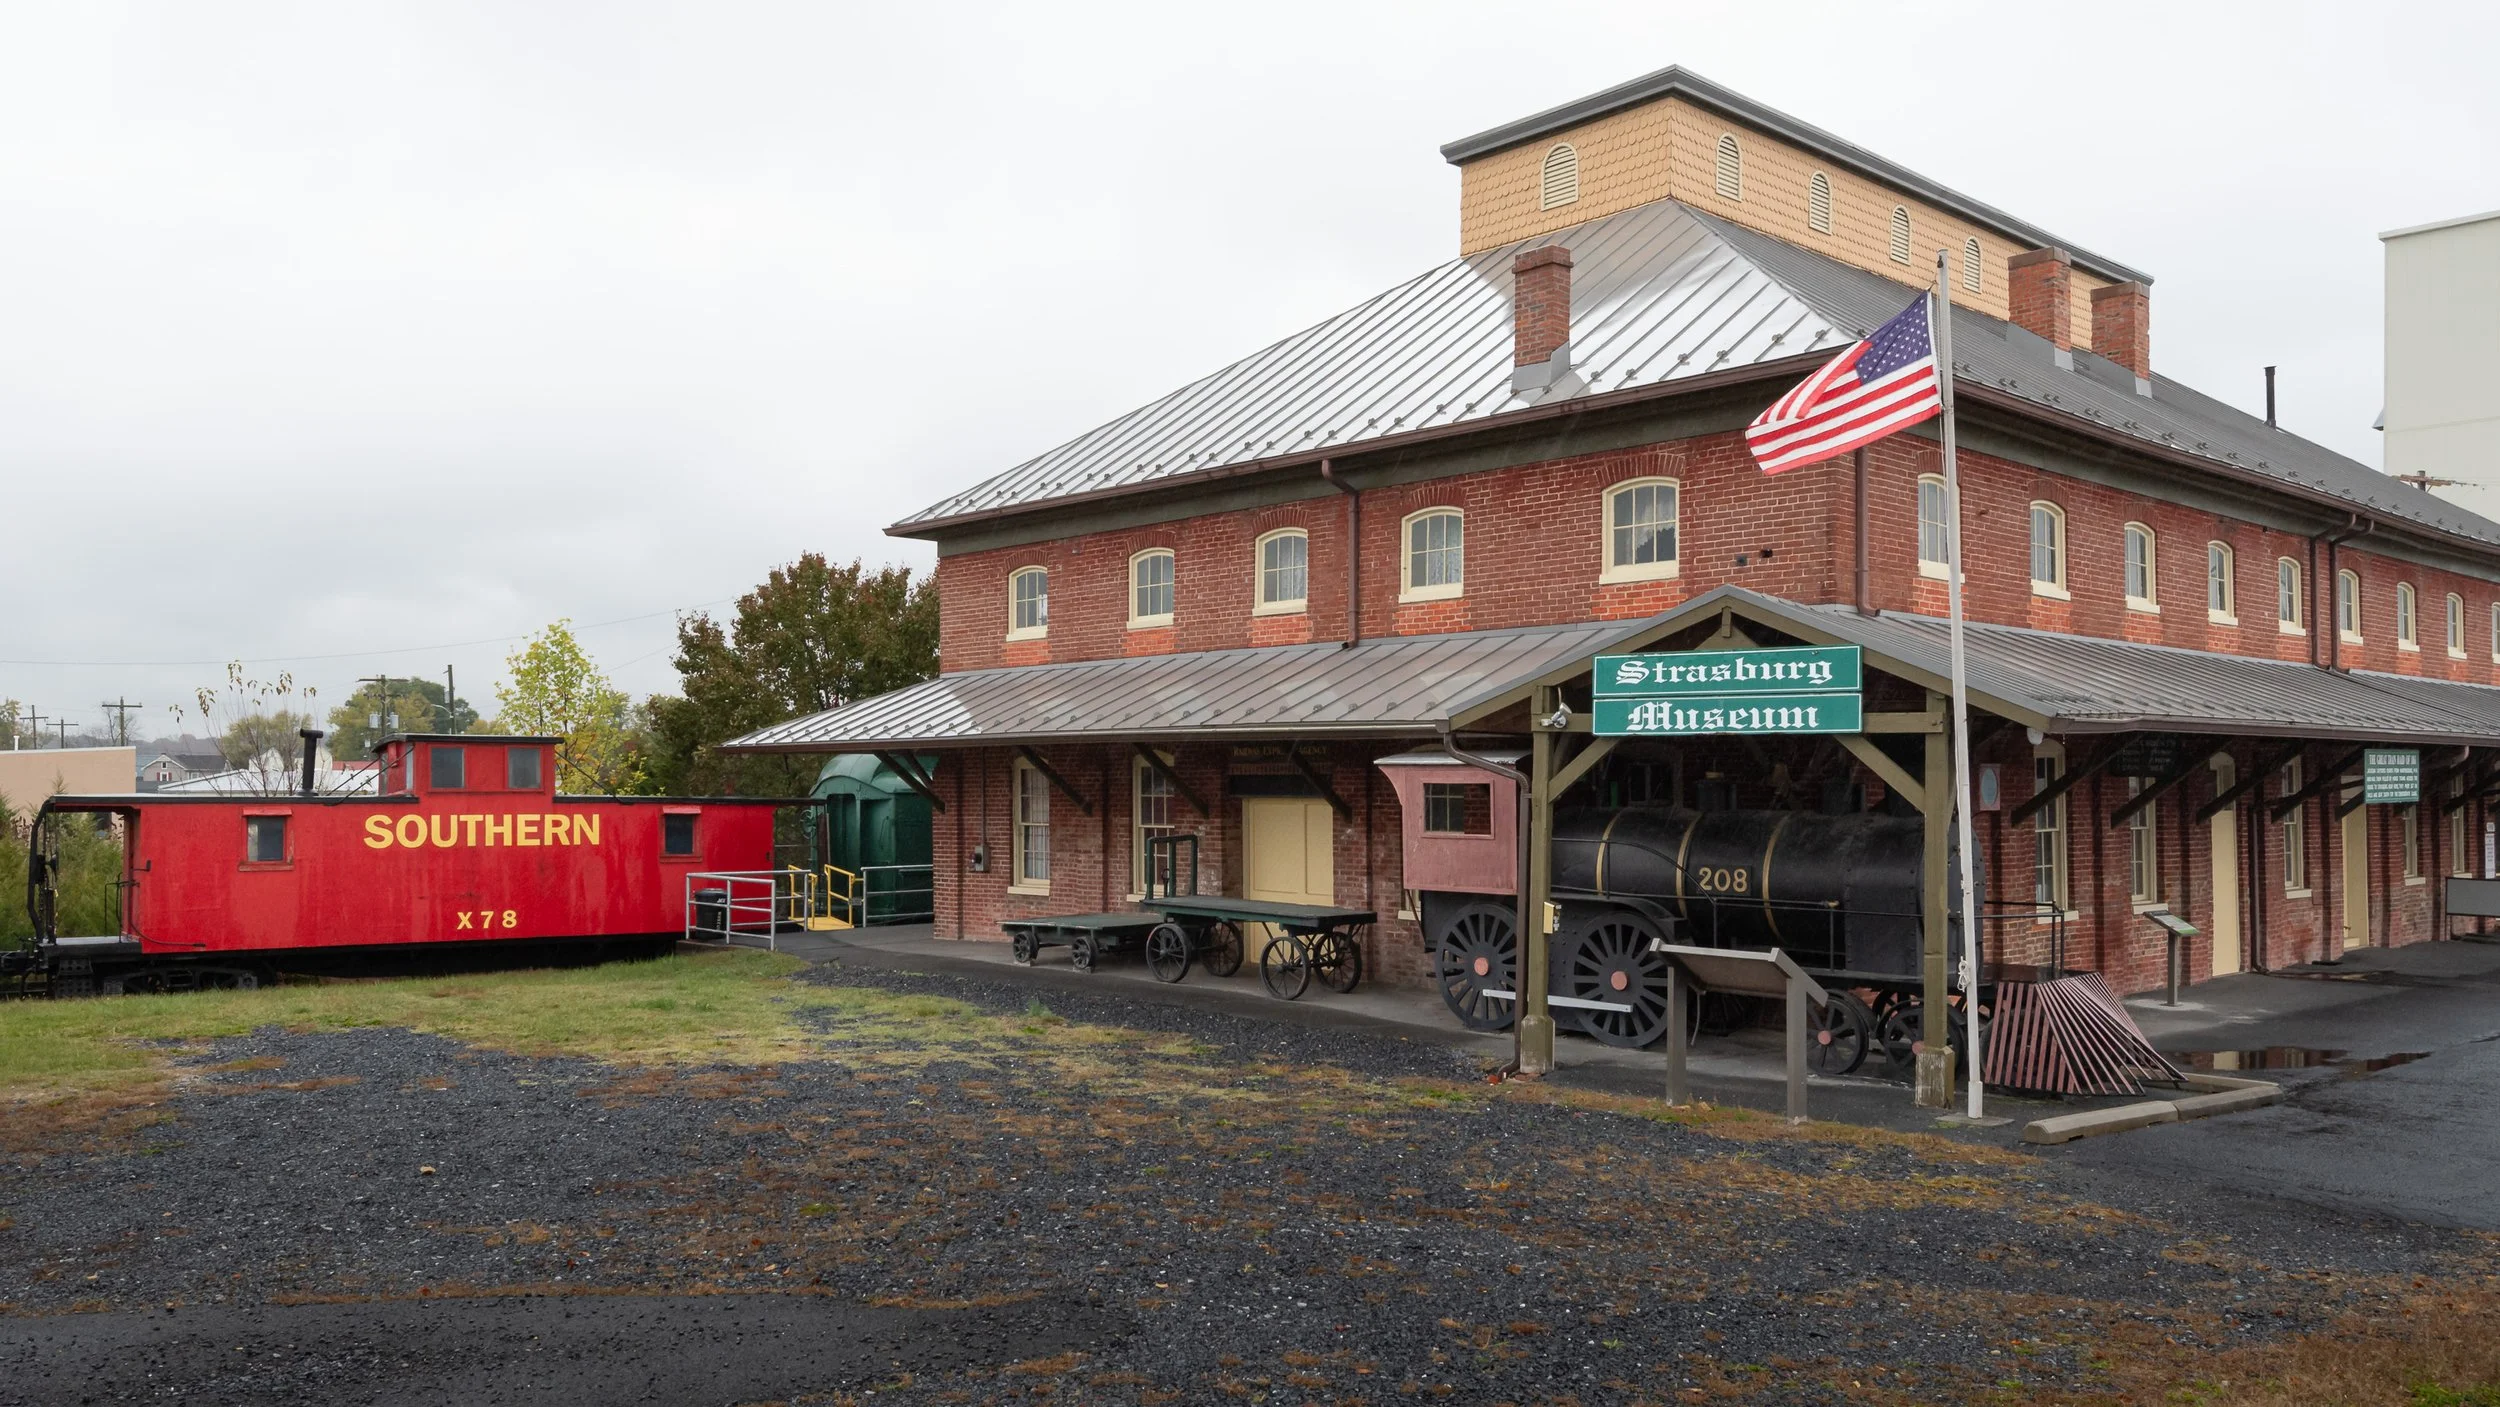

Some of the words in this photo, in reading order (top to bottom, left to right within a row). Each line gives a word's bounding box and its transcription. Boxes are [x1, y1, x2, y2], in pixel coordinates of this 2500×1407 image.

[1616, 657, 1833, 685] Strasburg
[1626, 701, 1820, 731] Museum
[363, 813, 600, 849] SOUTHERN
[1698, 866, 1748, 893] 208
